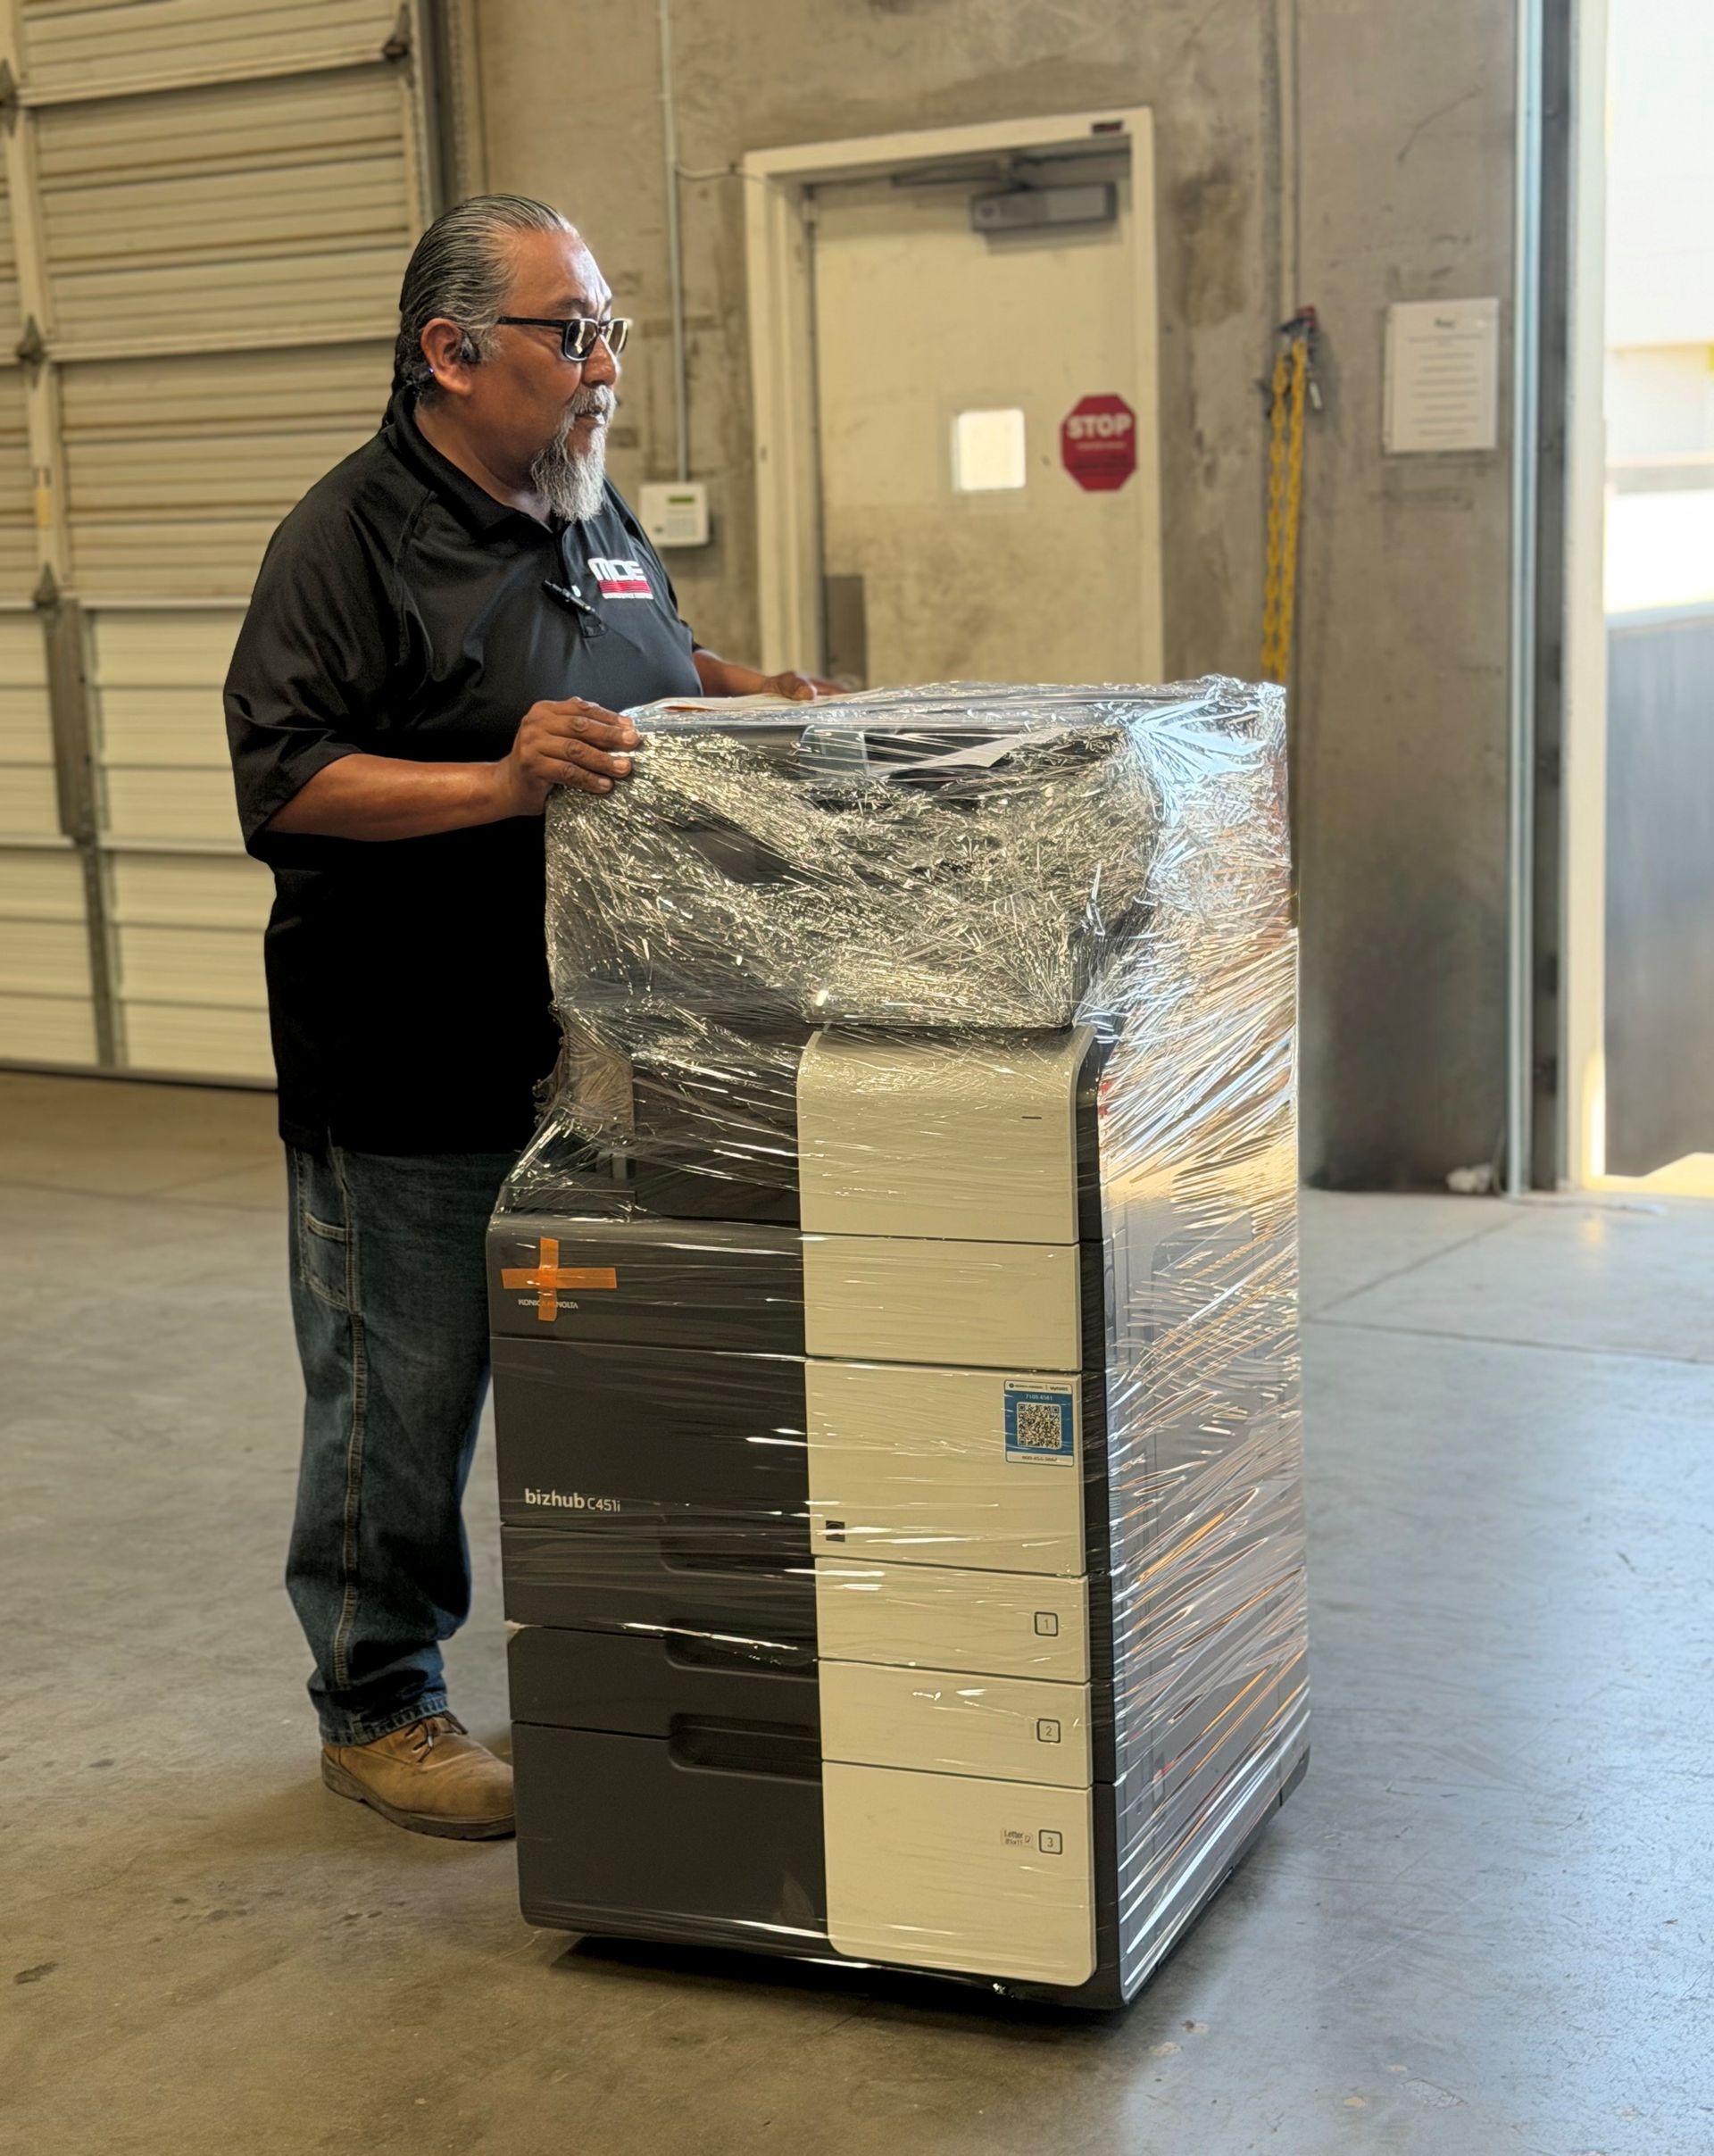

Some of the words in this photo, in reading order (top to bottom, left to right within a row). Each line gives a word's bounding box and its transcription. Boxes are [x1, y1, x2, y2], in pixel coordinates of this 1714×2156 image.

[1067, 412, 1131, 439] STOP
[547, 1301, 578, 1309] NOLTA
[525, 1488, 585, 1509] bizhub
[587, 1498, 620, 1512] C451i
[1044, 1619, 1048, 1629] 1
[1045, 1726, 1053, 1736] 2
[1047, 1837, 1053, 1848] 3
